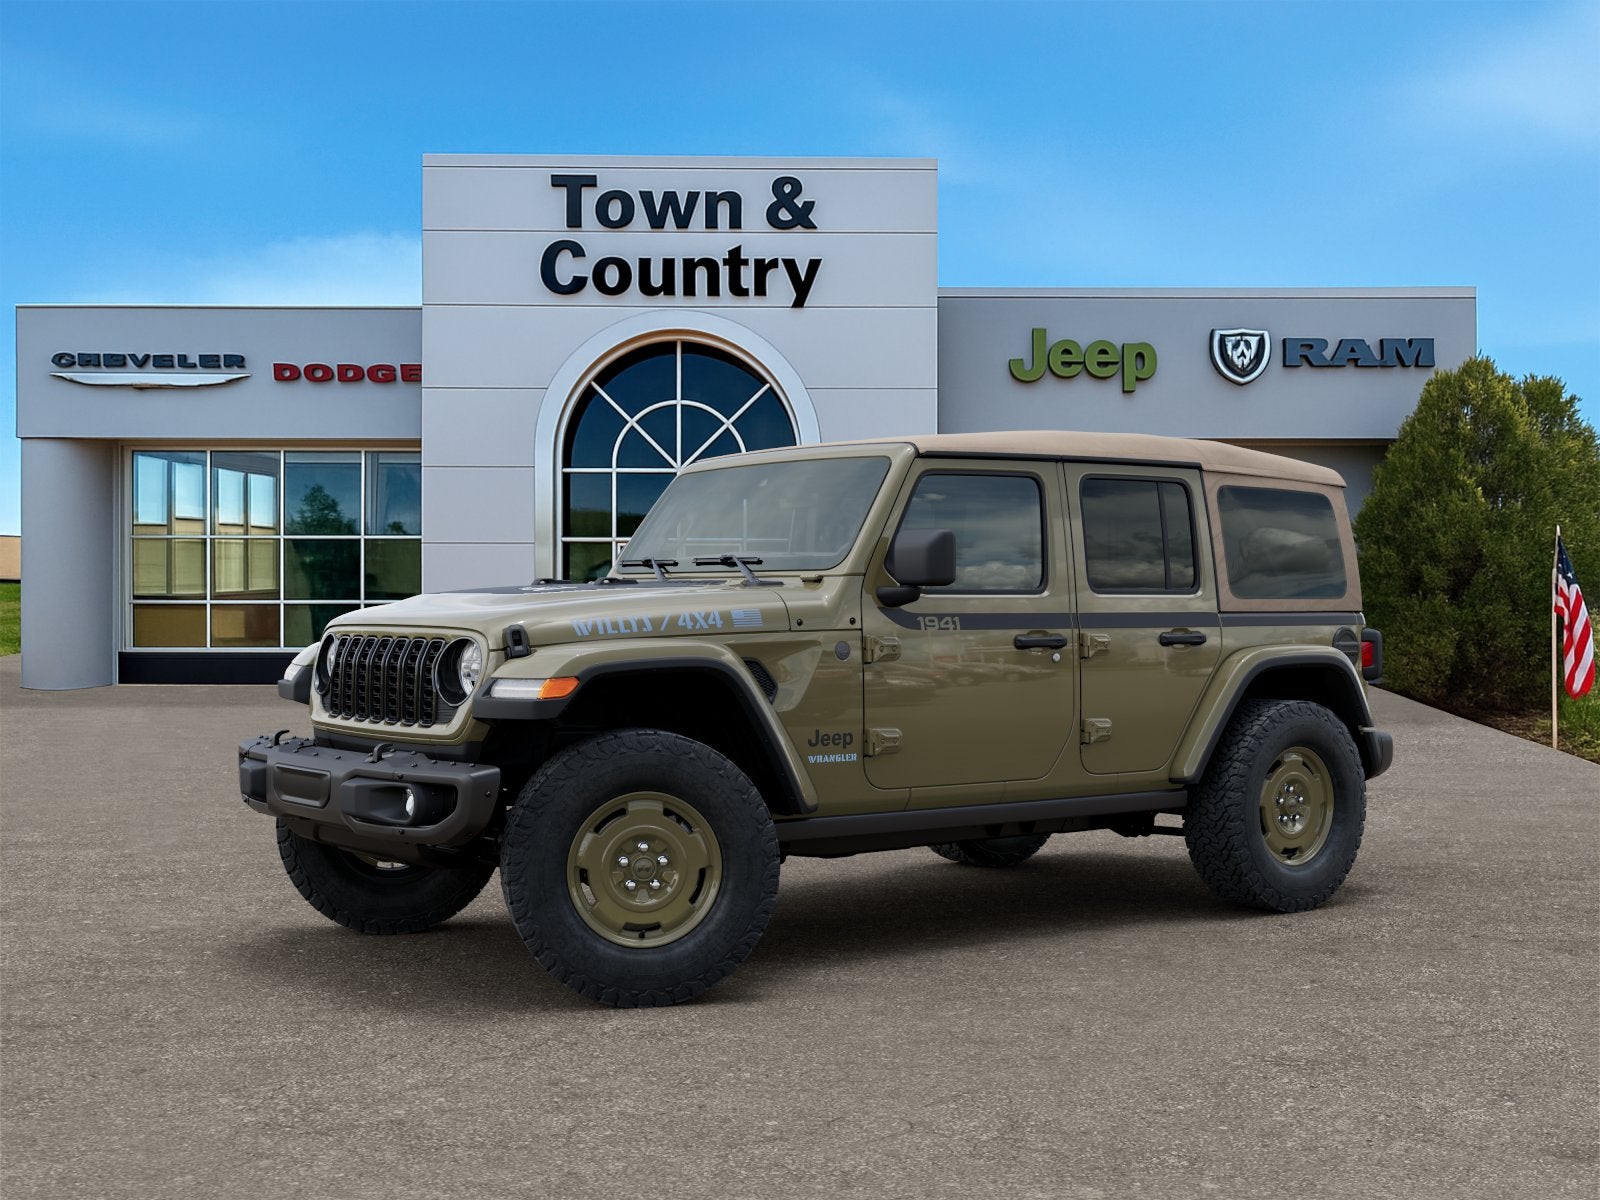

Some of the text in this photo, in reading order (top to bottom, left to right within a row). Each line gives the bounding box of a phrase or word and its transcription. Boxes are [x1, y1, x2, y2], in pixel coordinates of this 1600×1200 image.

[550, 174, 818, 230] Town &
[539, 239, 823, 308] Country
[1008, 327, 1158, 393] Jeep
[1282, 337, 1436, 368] RAM
[273, 362, 422, 383] DODGE
[570, 614, 652, 637] WILLYS
[916, 616, 961, 631] 1941
[807, 729, 853, 748] Jeep
[807, 753, 857, 764] WRANGLER
